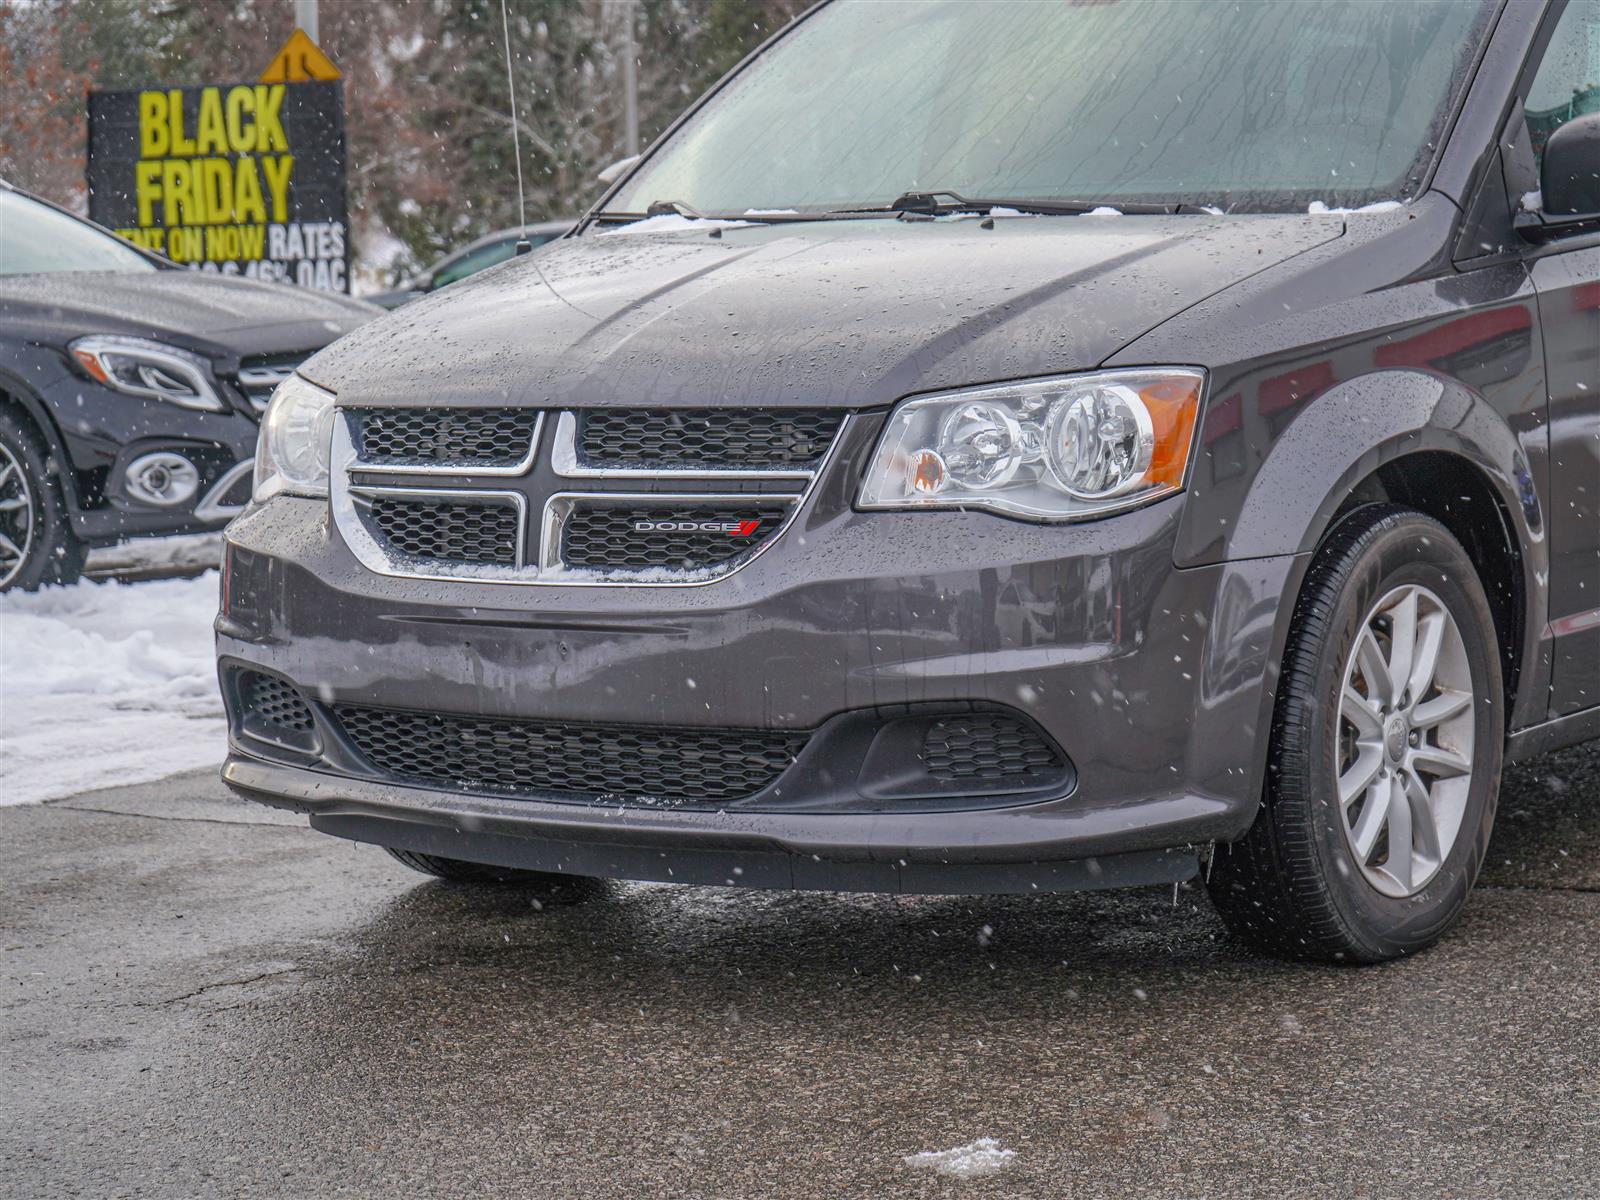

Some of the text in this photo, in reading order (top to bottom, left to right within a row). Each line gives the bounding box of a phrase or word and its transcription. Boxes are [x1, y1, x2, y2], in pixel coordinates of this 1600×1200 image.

[138, 84, 288, 158] BLACK
[135, 154, 293, 227] FRIDAY
[168, 226, 203, 262] ON
[206, 223, 265, 262] NOW
[268, 221, 345, 260] RATES
[297, 258, 346, 292] OAC
[635, 521, 741, 531] DODGE
